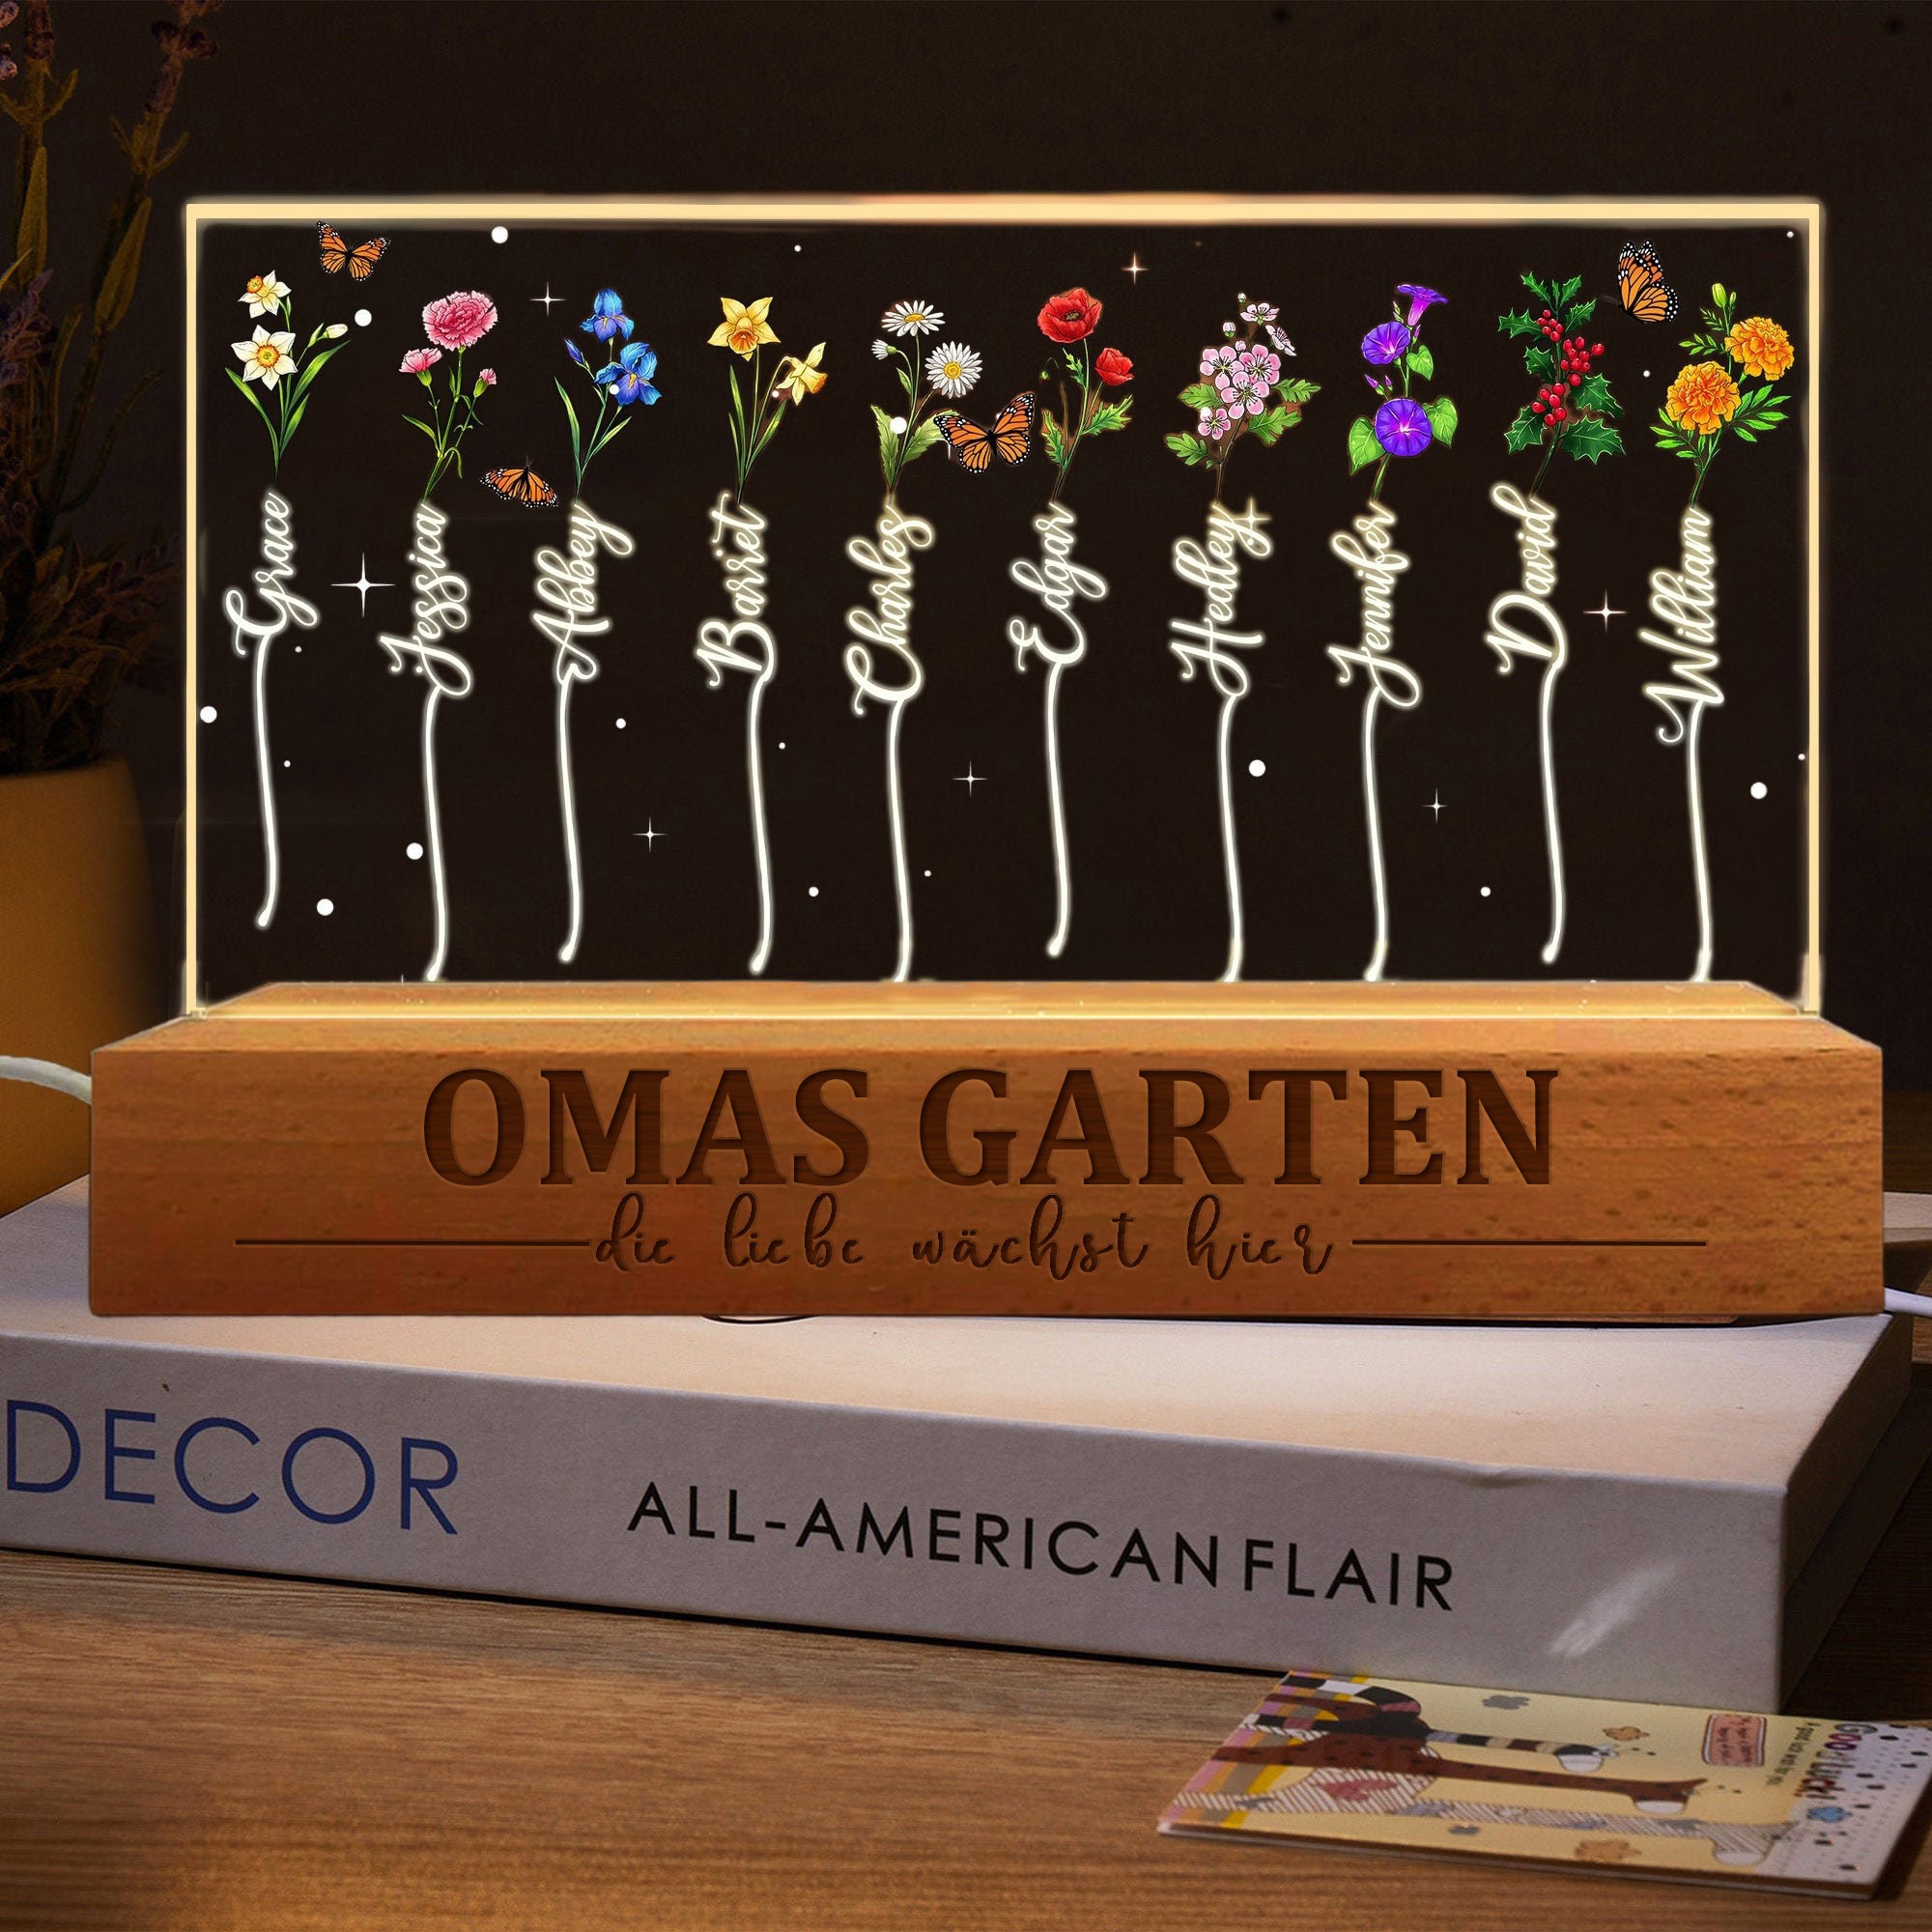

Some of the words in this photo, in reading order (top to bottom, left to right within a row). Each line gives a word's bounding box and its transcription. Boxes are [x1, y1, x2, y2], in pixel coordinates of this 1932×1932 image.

[225, 491, 319, 657] Grace
[378, 502, 471, 696] Jessica
[532, 503, 633, 685] Abbey
[845, 503, 933, 716] Charles
[1009, 502, 1106, 672] Edgar
[1170, 501, 1271, 697] Hedley
[1327, 501, 1420, 707] Jennifer
[1486, 484, 1566, 675] David
[1639, 507, 1725, 743] William
[423, 1068, 869, 1186] OMAS
[919, 1068, 1559, 1186] GARTEN
[595, 1192, 674, 1272] die
[724, 1192, 864, 1268] liebe
[912, 1194, 1149, 1281] wächst
[1186, 1194, 1333, 1281] hier
[6, 1399, 459, 1536] DECOR
[627, 1481, 1218, 1588] ALL-AMERICAN
[1244, 1538, 1453, 1611] FLAIR
